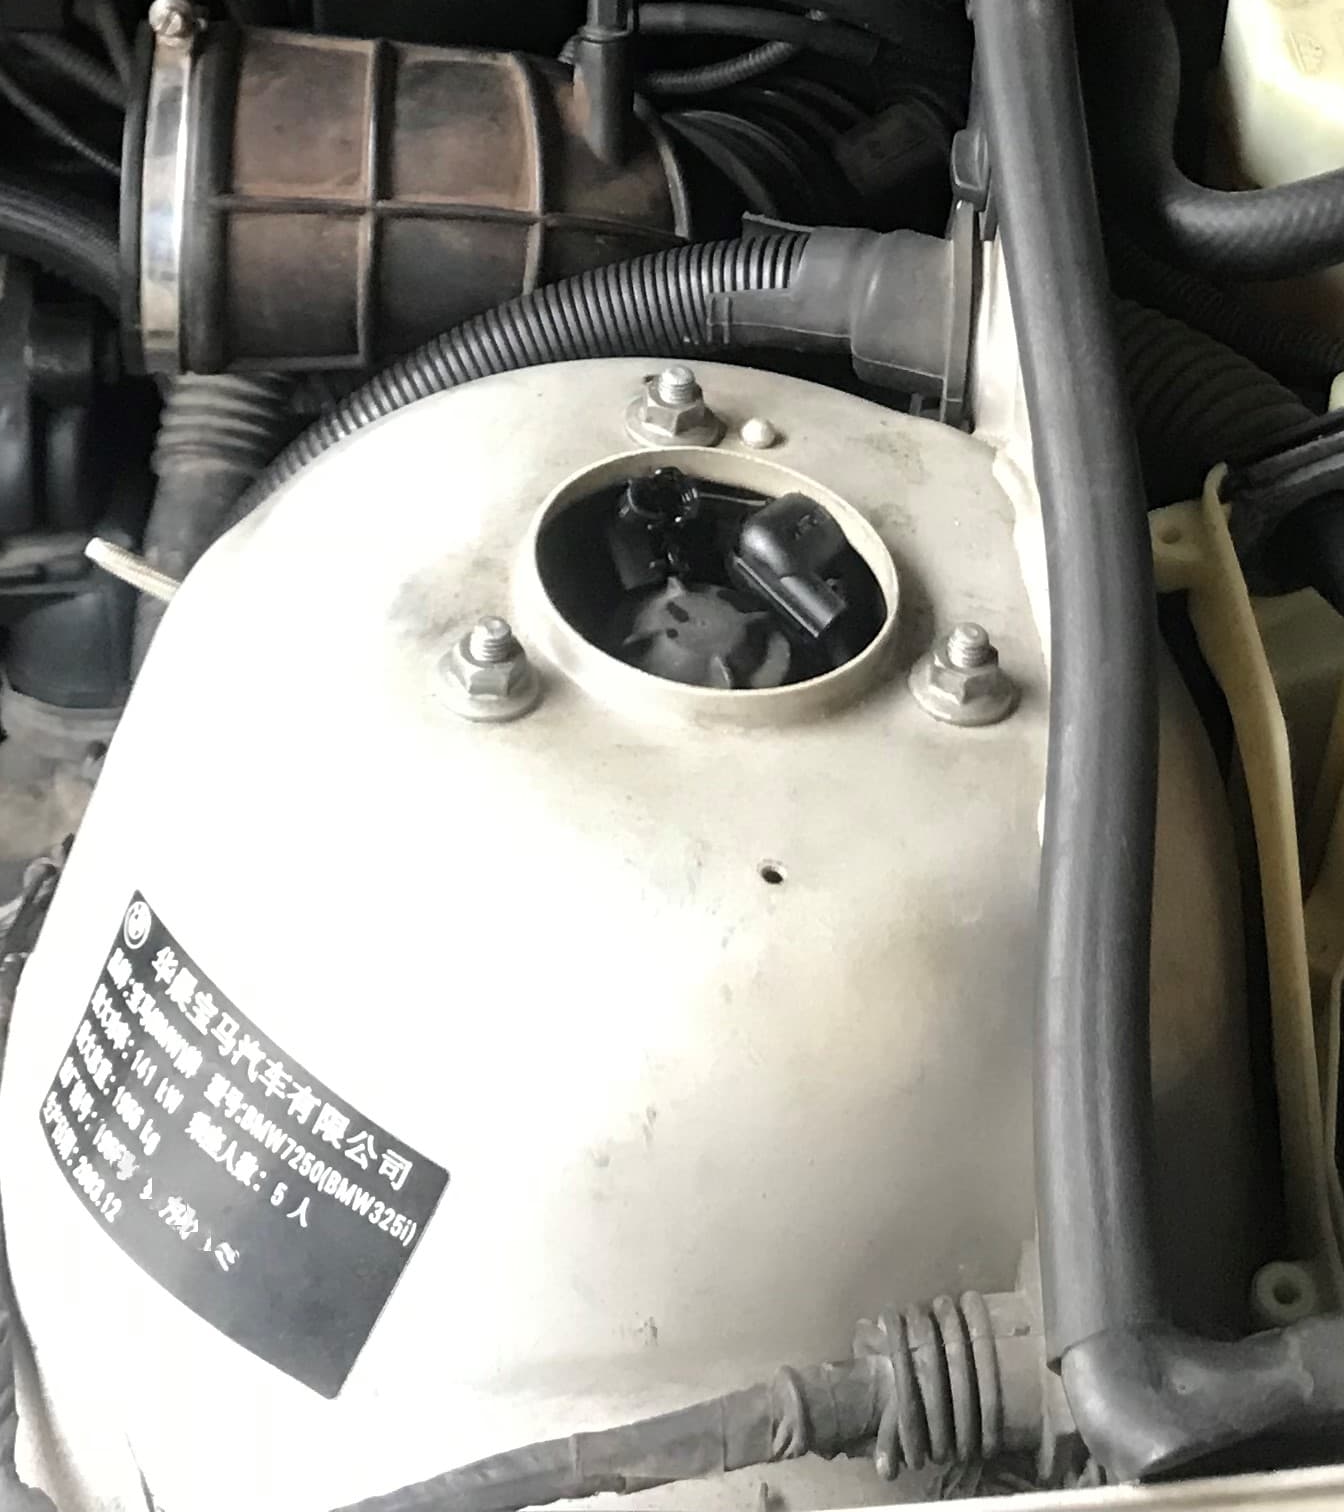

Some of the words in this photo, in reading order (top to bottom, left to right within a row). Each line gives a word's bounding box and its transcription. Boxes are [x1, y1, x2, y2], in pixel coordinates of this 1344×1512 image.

[152, 946, 413, 1191] 华晨宝马汽车有限公司
[271, 1181, 288, 1207] 5
[287, 1196, 311, 1228] 人
